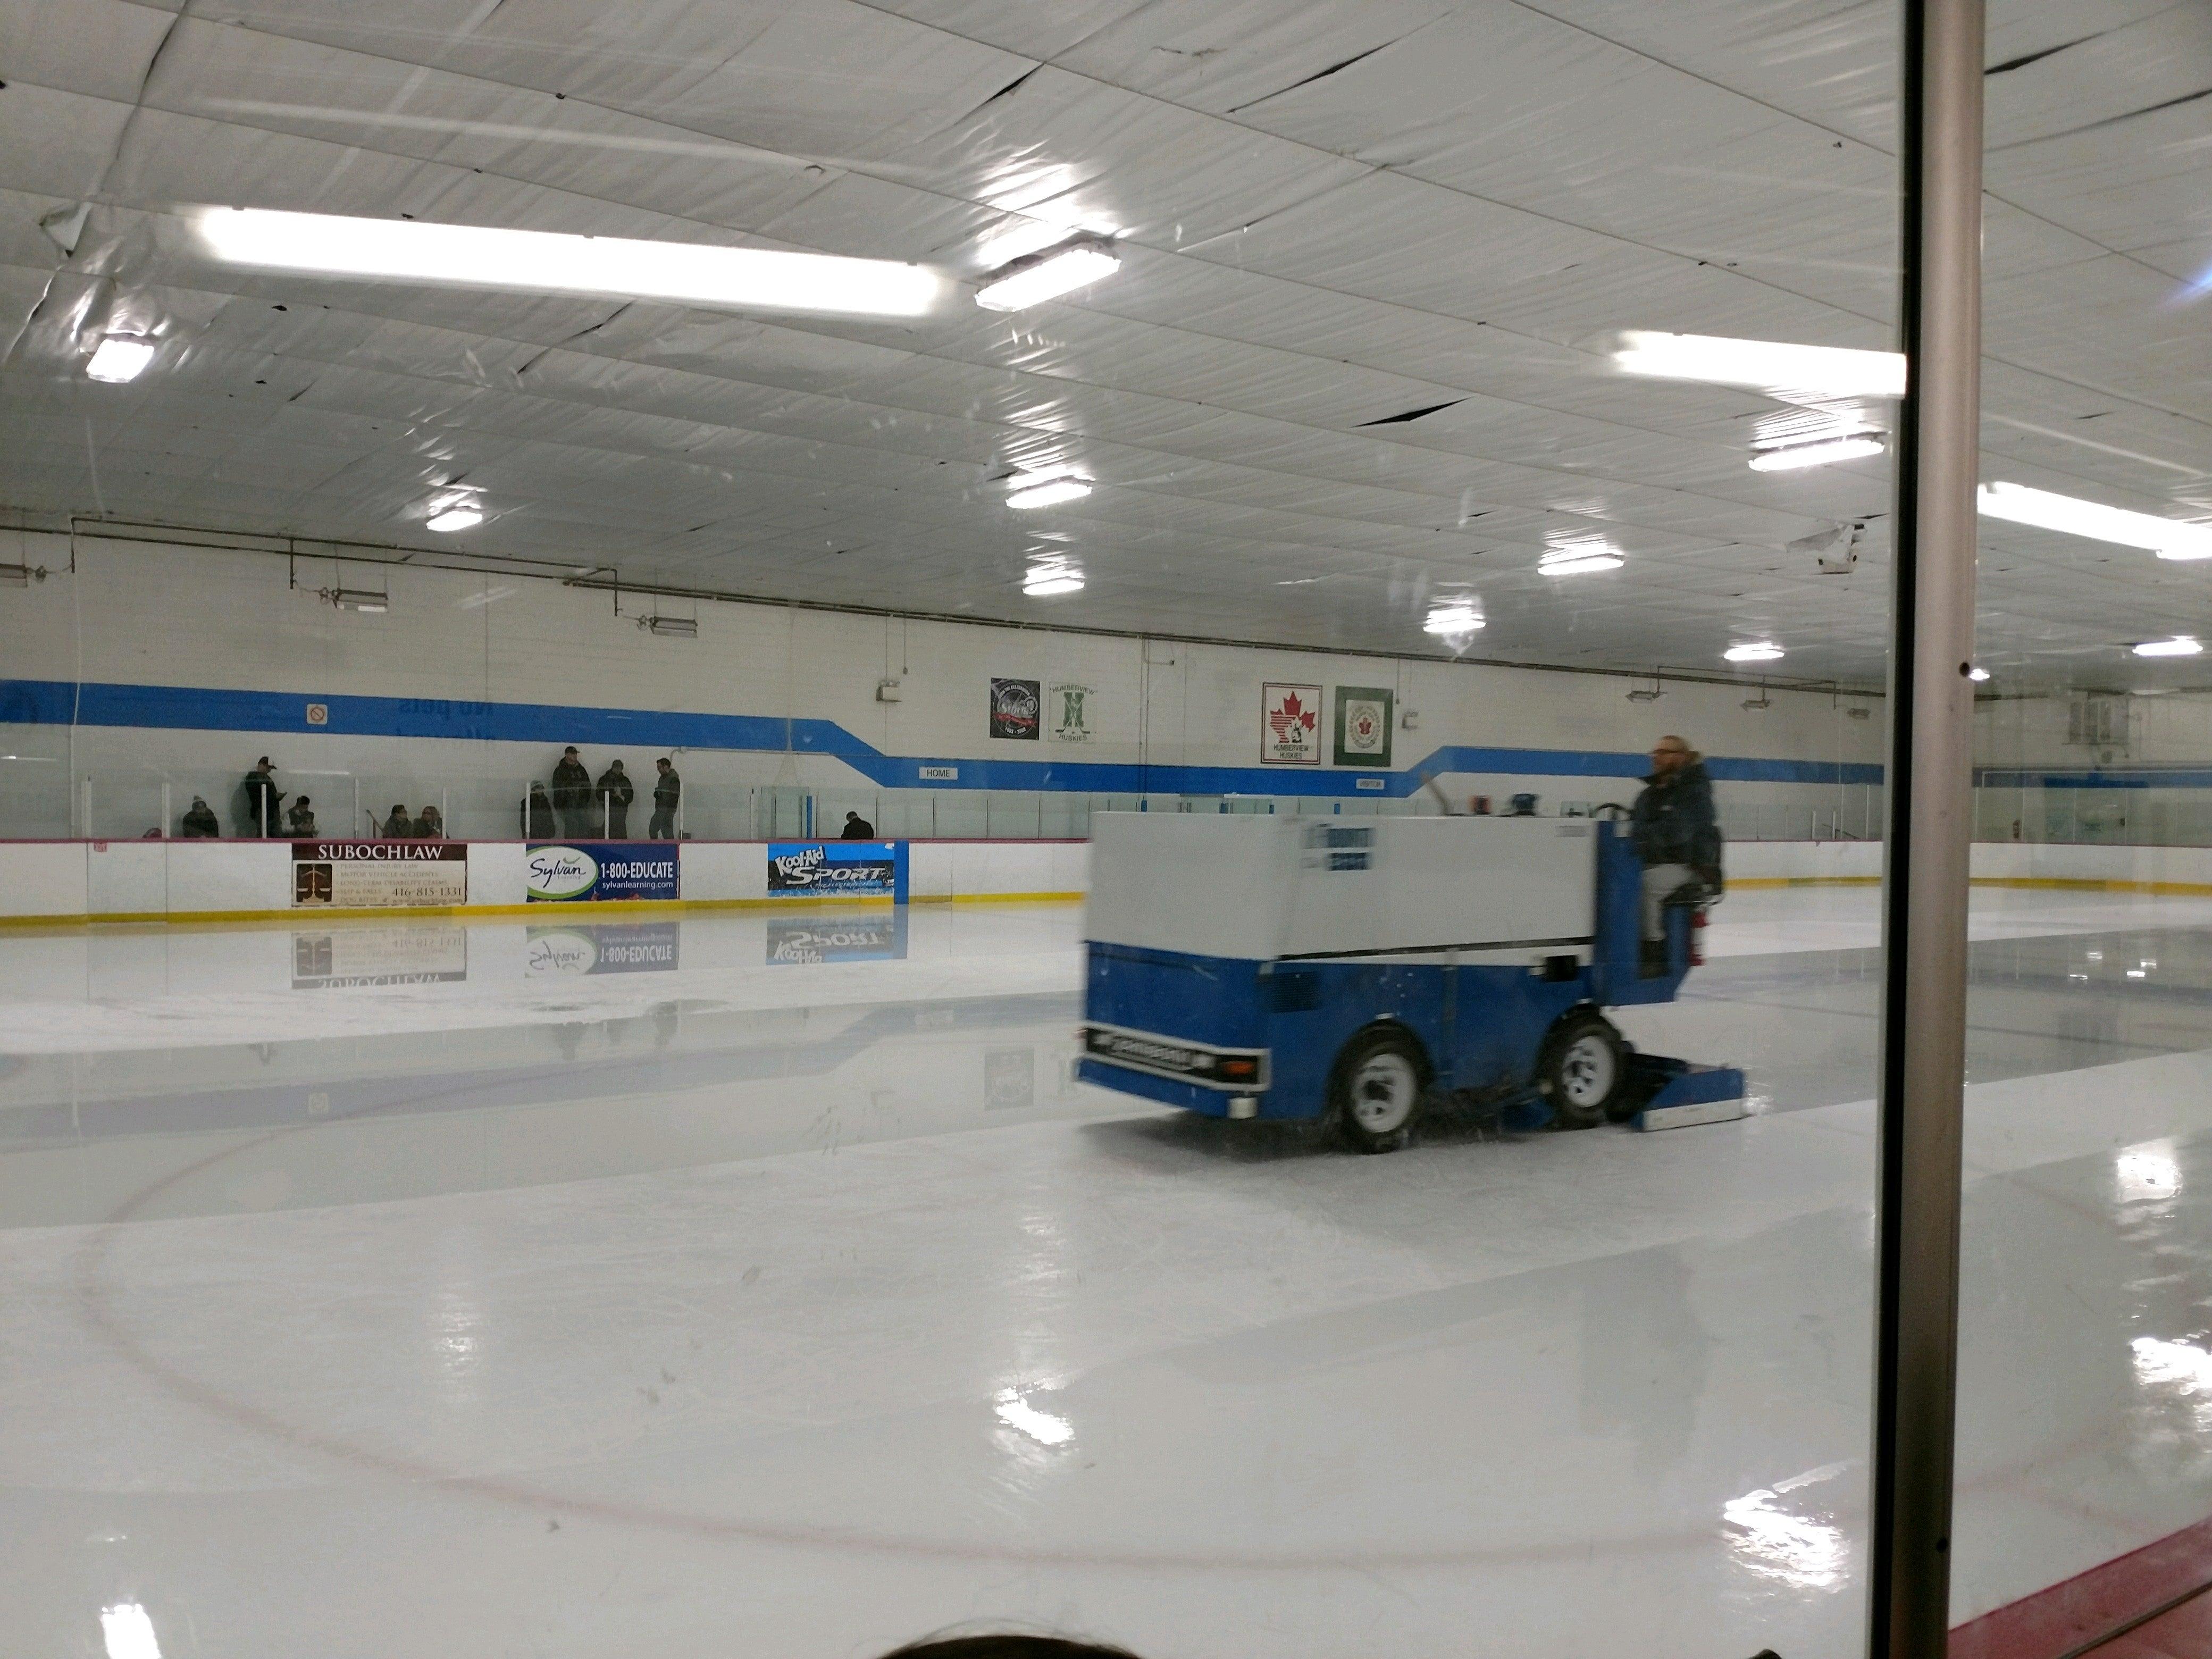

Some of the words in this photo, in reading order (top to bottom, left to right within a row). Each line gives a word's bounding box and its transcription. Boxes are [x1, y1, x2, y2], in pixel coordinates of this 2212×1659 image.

[318, 845, 443, 860] SUBOCHLAW
[530, 858, 586, 888] Sylvan
[601, 861, 673, 878] 1-800-EDUCATE
[786, 867, 886, 885] SPORT
[602, 880, 673, 890] sylvanlearning.com
